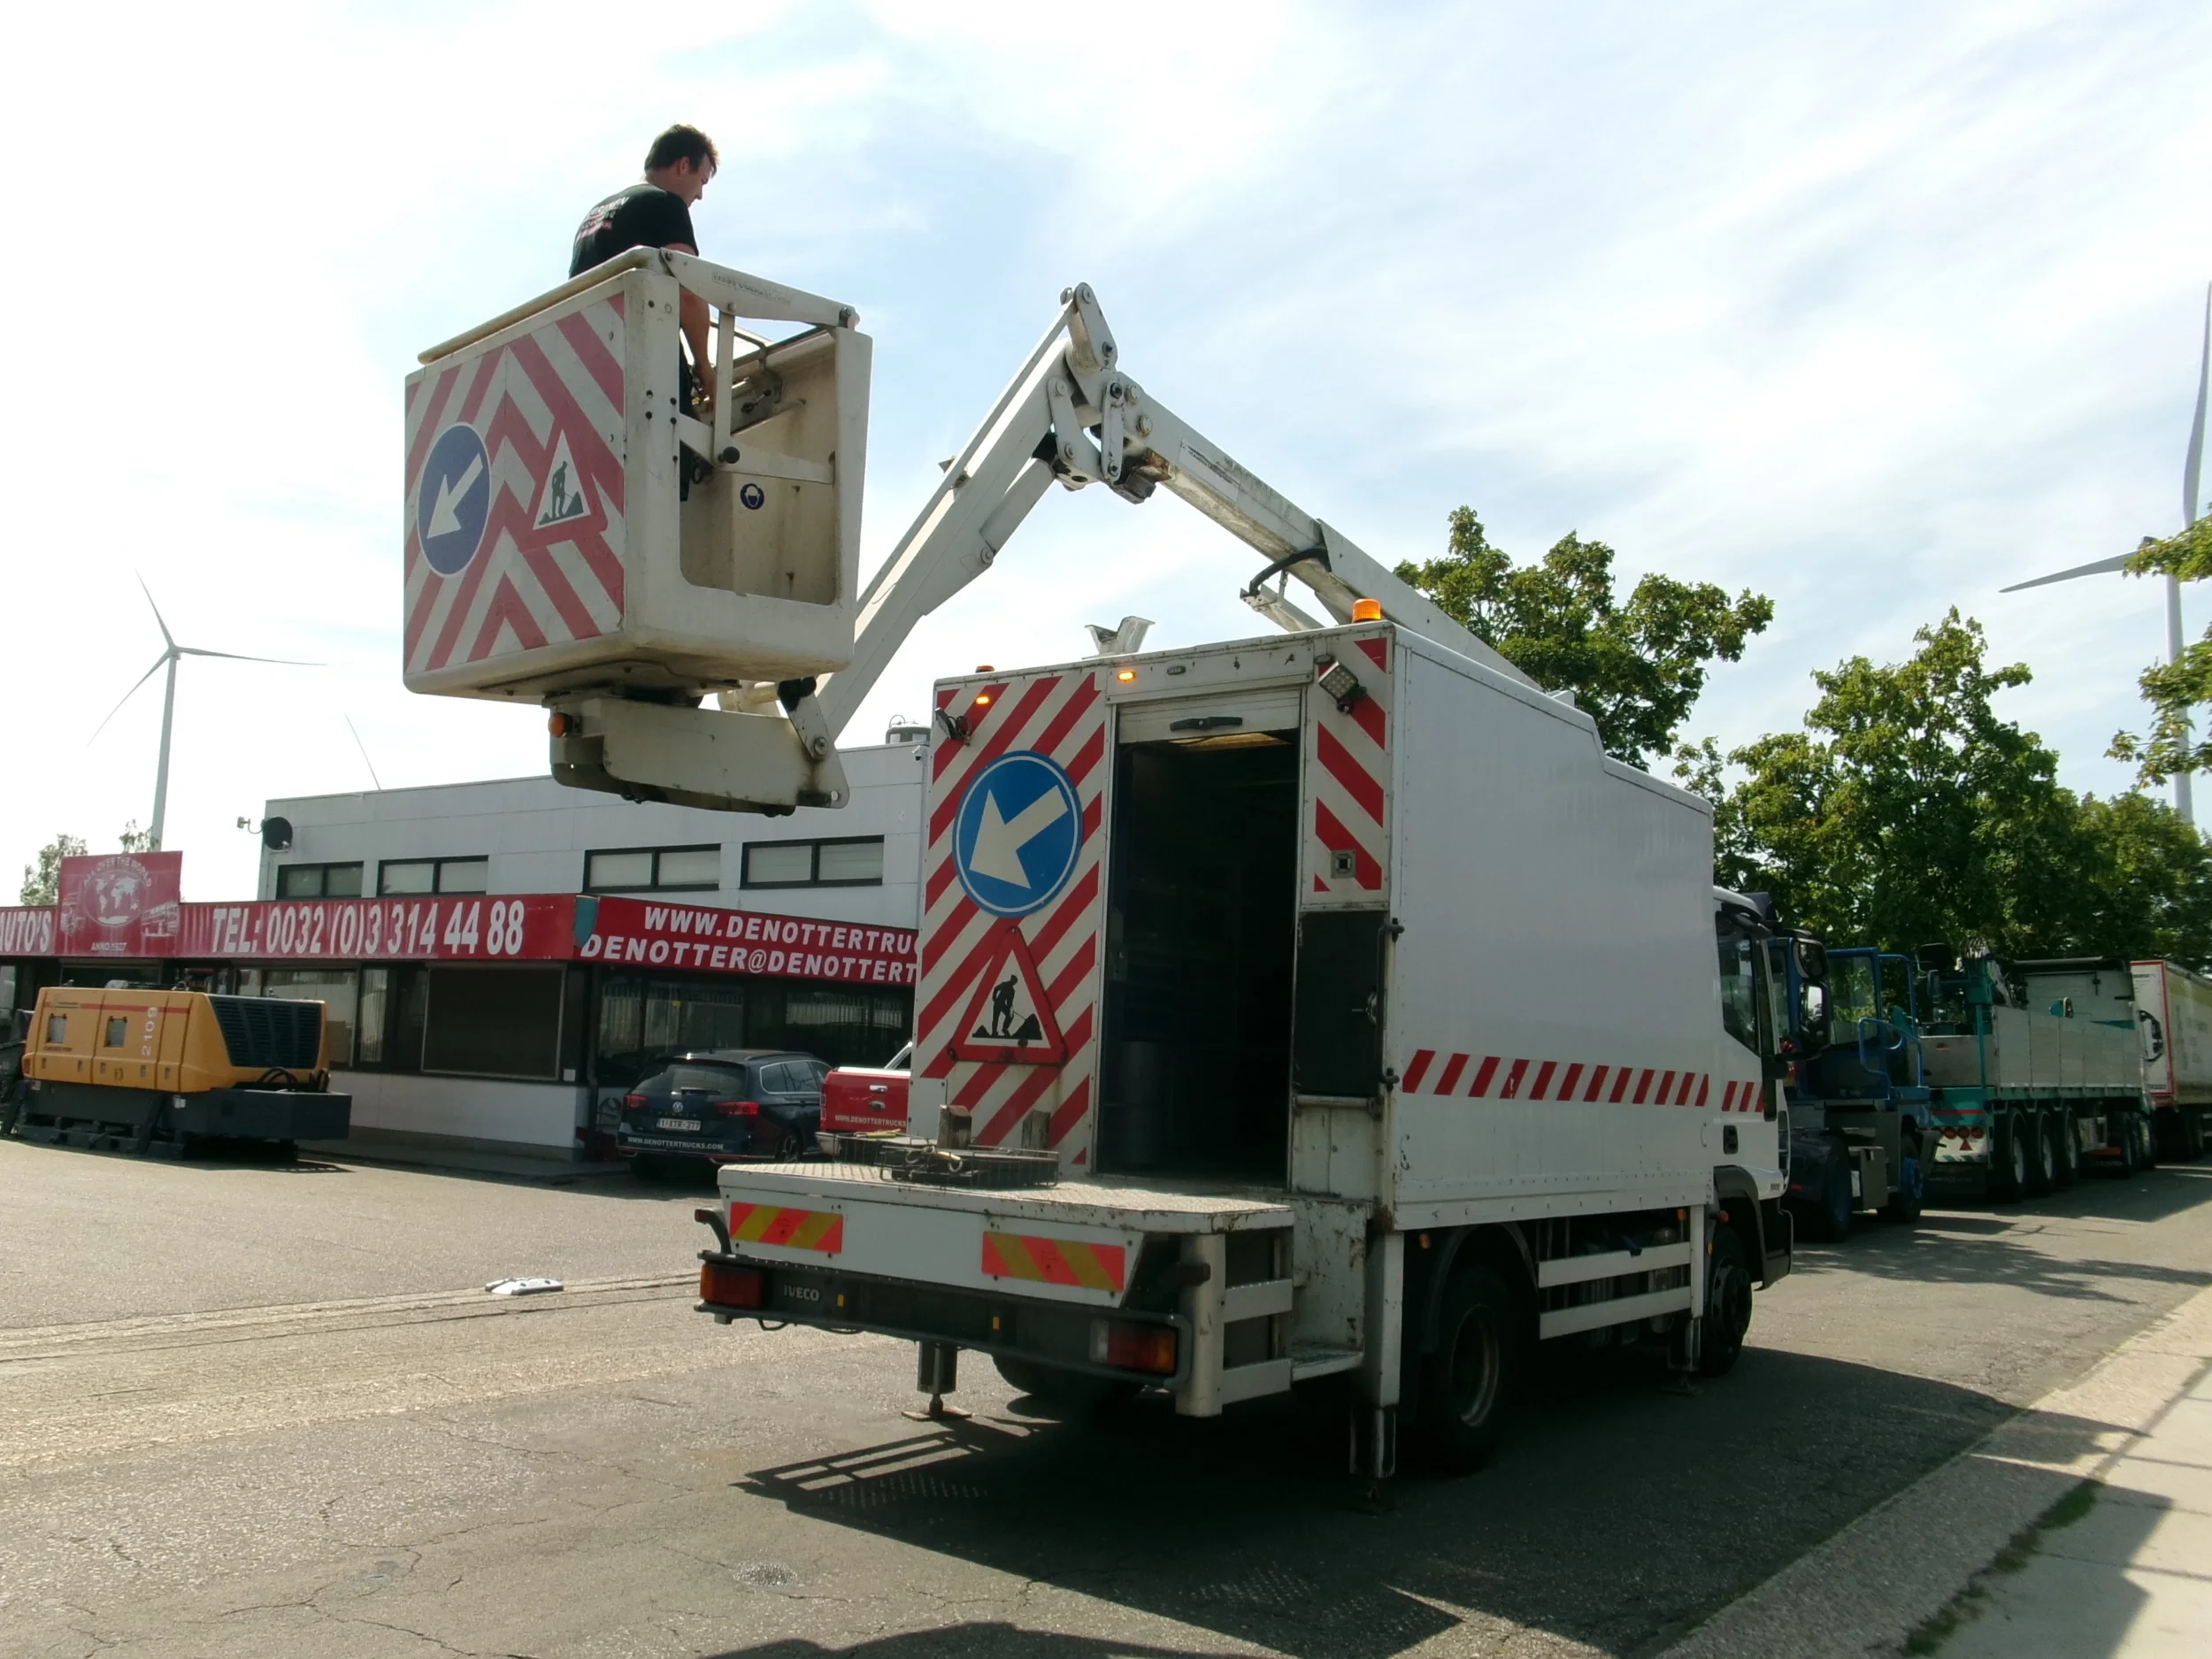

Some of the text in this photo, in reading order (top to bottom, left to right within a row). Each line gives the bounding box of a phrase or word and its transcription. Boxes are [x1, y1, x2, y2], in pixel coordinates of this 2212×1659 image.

[211, 908, 261, 953] TEL:
[266, 906, 325, 954] 0032
[388, 902, 439, 955] 314
[443, 901, 480, 955] 44
[487, 900, 525, 956] 88
[834, 1115, 906, 1127] WWW.DENOTTERTRUCKS
[627, 1136, 724, 1149] WWW.DENOTTERTRUCKS.COM
[783, 1284, 820, 1302] IVECO
